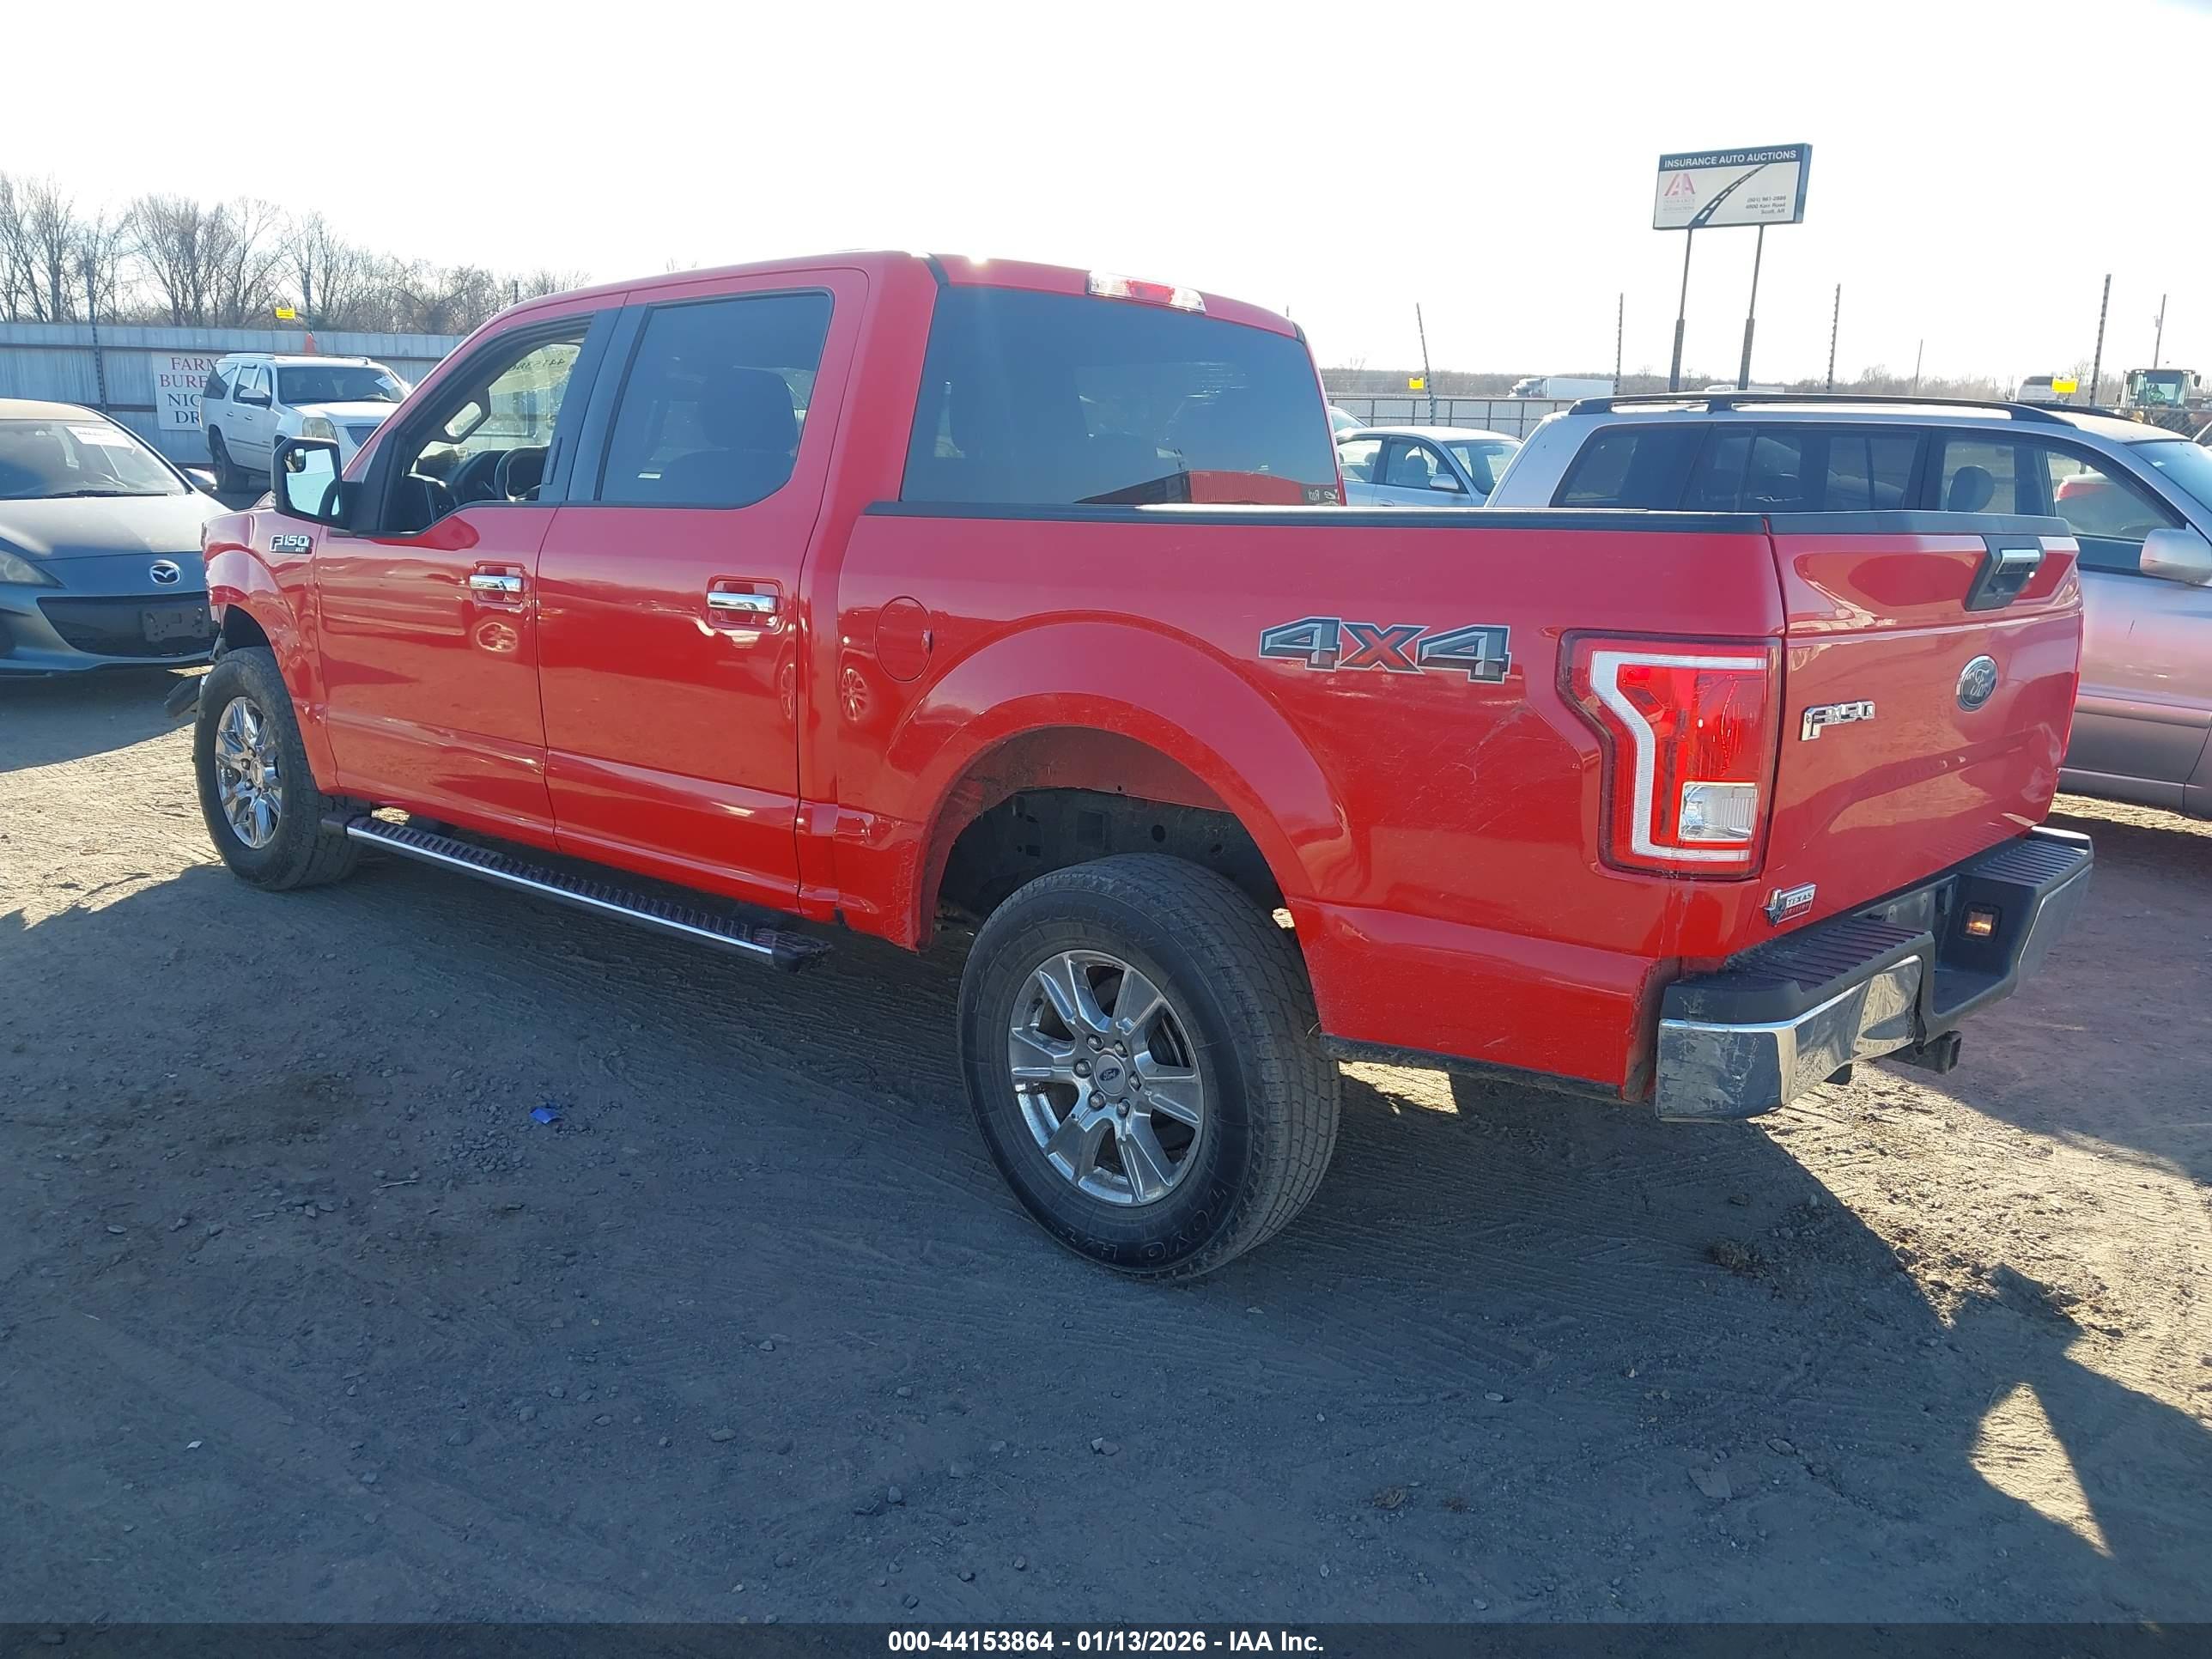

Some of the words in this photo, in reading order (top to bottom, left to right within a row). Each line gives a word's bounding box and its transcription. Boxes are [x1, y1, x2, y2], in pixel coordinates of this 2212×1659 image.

[1664, 155, 1717, 168] INSURANCE
[1718, 154, 1745, 164] AUTO
[1747, 149, 1797, 162] AUCTIONS
[171, 357, 220, 372] FARM
[160, 374, 207, 388] BURE
[174, 411, 200, 424] DR
[1786, 891, 1814, 907] TEXAS
